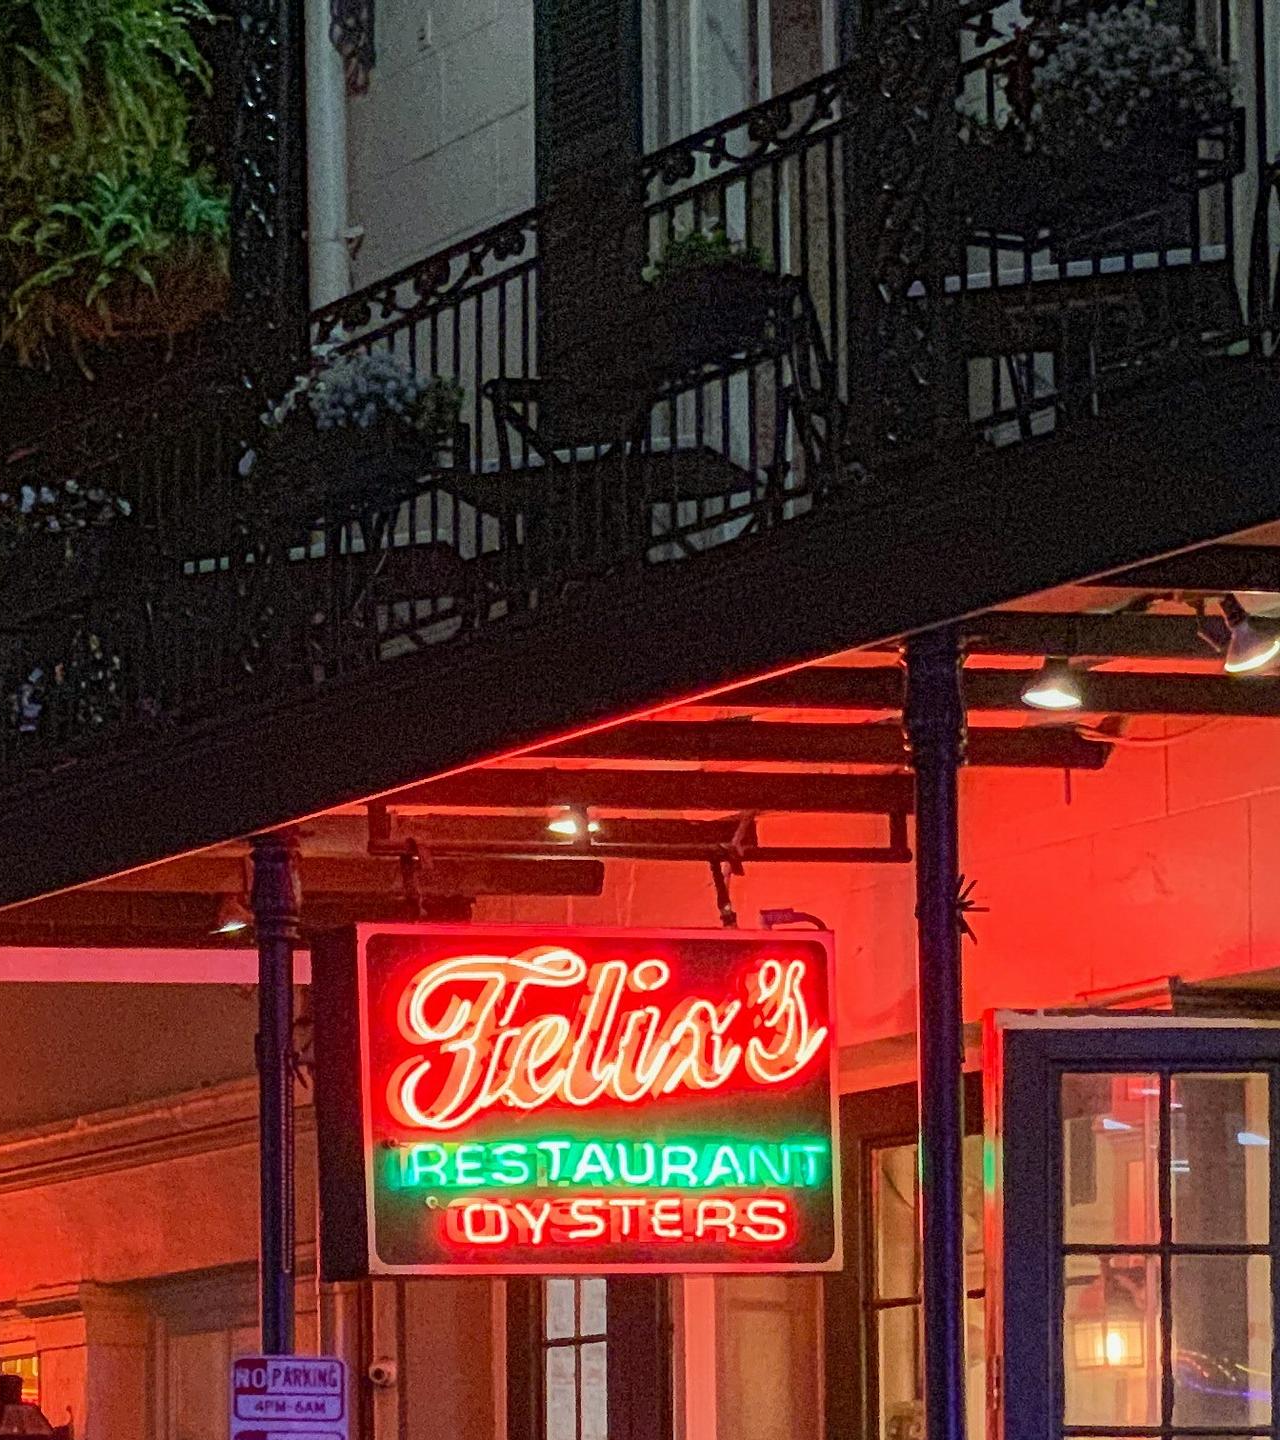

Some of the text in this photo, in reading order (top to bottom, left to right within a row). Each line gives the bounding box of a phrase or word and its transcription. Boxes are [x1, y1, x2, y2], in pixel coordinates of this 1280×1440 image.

[395, 947, 829, 1131] Felix's
[406, 1139, 828, 1187] RESTAURANT
[456, 1198, 788, 1245] OYSTERS
[236, 1366, 338, 1388] NO PARKING
